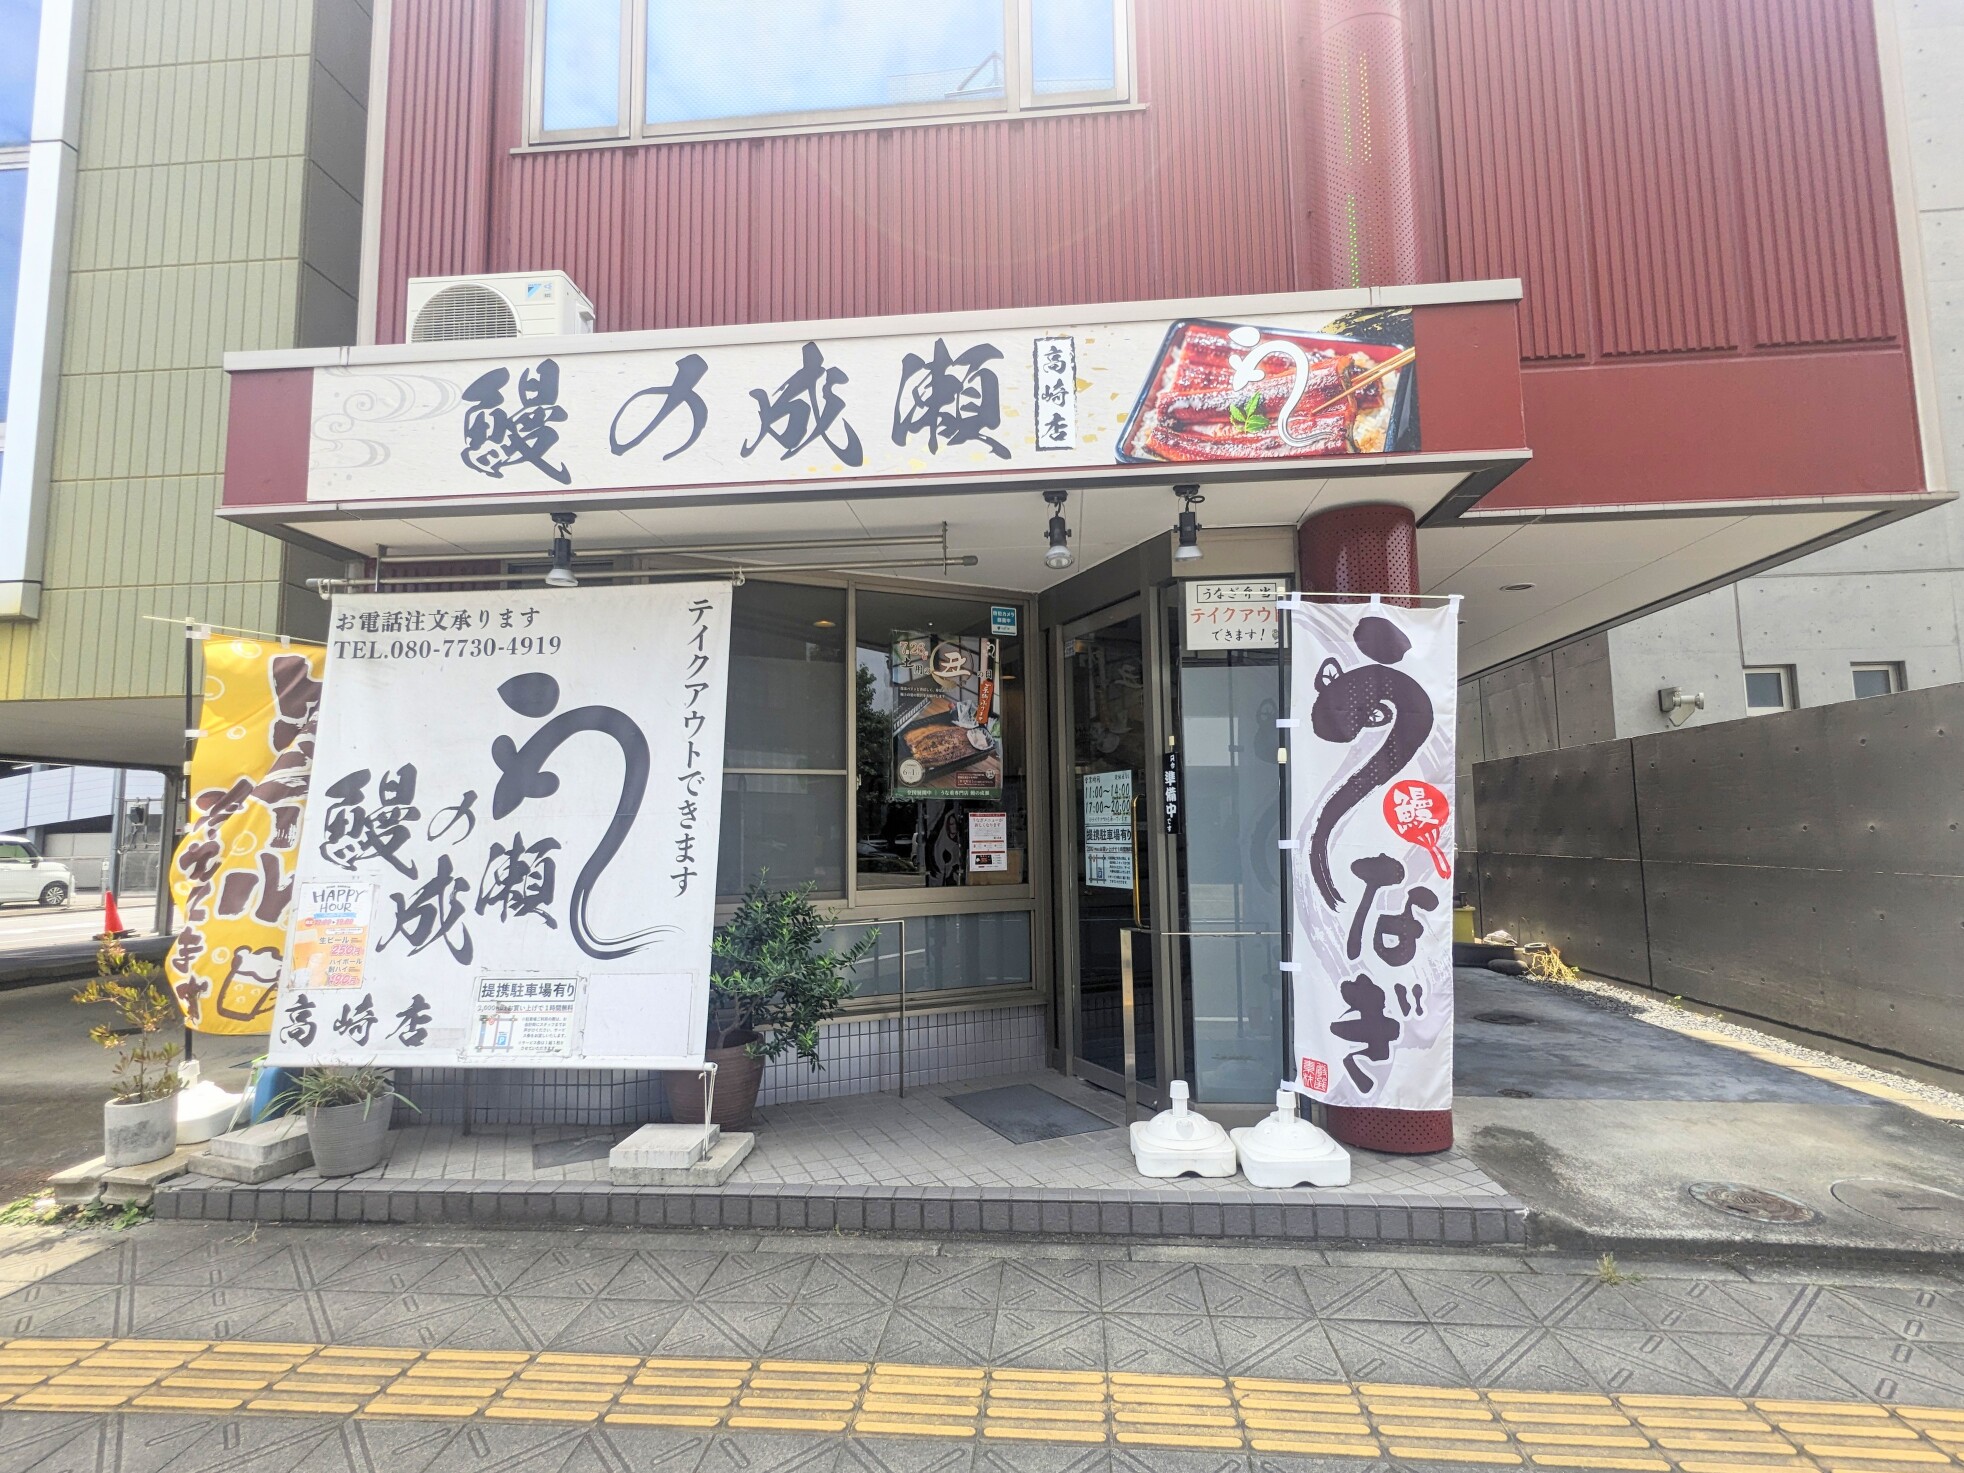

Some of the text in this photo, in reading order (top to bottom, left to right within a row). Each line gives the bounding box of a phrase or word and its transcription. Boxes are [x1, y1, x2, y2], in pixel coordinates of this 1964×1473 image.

[1040, 345, 1069, 443] 高崎店
[461, 338, 1012, 485] 鰻の成瀬
[335, 606, 542, 634] お電話注文承ります
[334, 635, 562, 660] TEL.080-7730-4919
[1212, 628, 1265, 641] できます!
[670, 598, 714, 898] テイクアウトできます
[1164, 754, 1177, 832] 只今準備中です
[1309, 616, 1440, 1095] うなぎ
[312, 889, 366, 904] HAPPY
[319, 902, 352, 913] HOUR
[319, 937, 350, 945] 生ビール
[329, 958, 363, 966] ハイボール
[481, 982, 575, 998] 提携駐車場有り
[279, 992, 433, 1048] 高崎店
